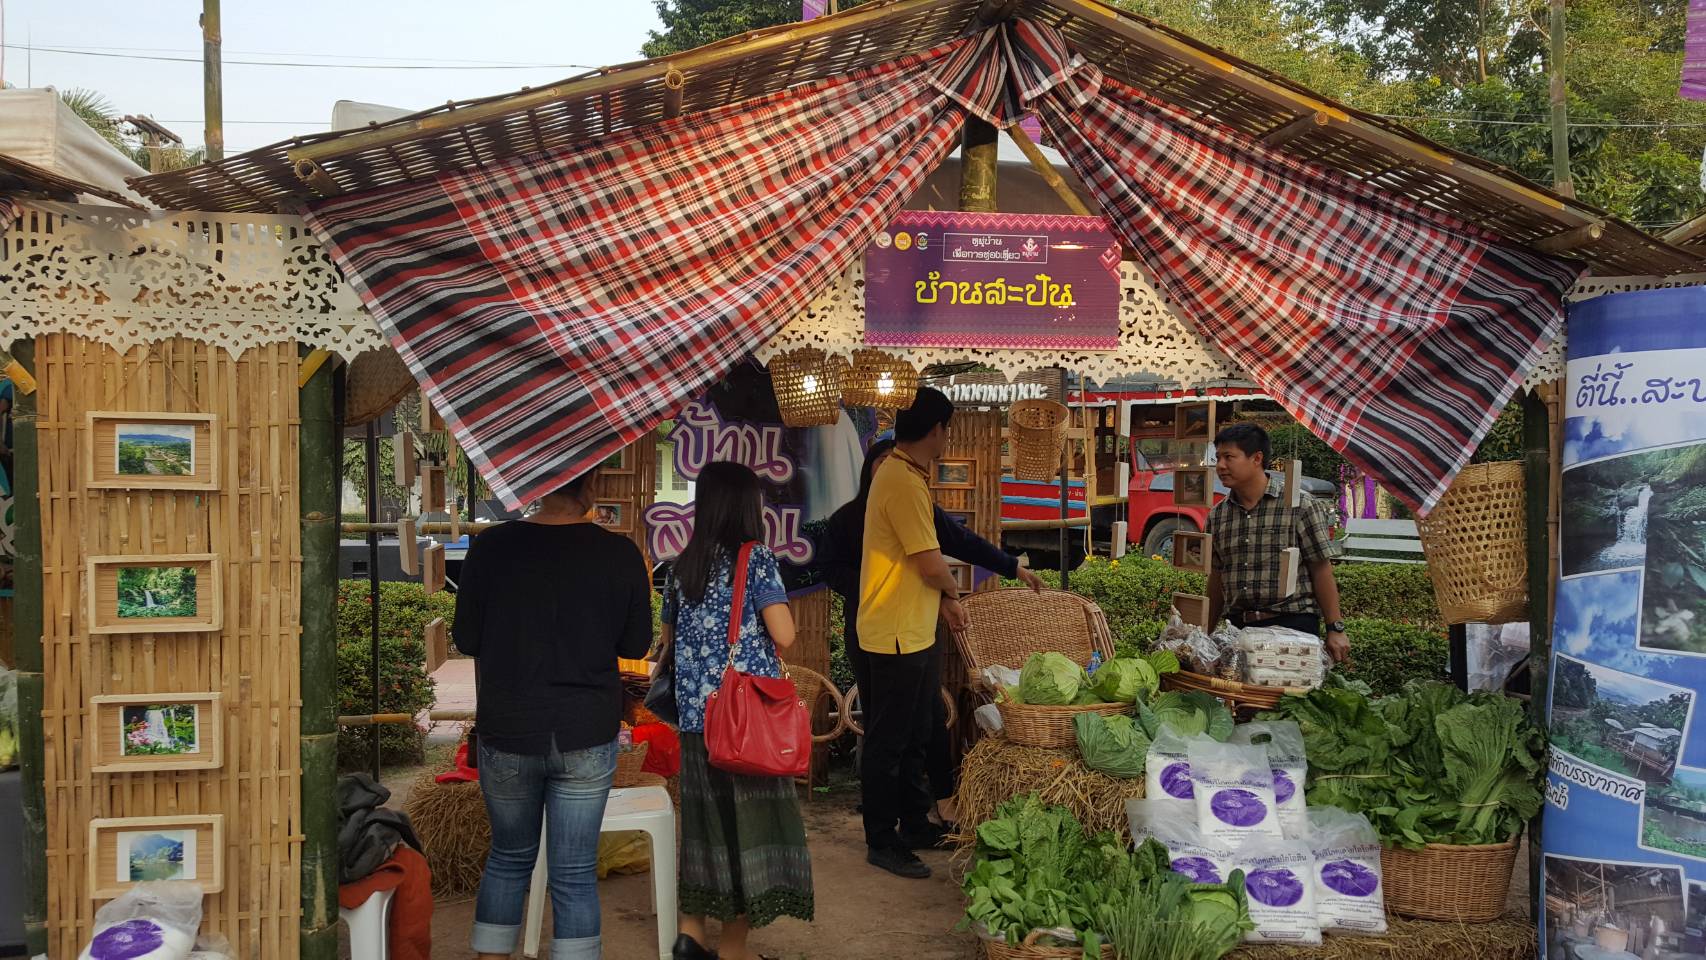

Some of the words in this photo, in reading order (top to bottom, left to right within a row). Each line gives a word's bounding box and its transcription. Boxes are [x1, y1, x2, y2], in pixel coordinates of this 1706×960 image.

[972, 235, 1003, 247] หมู่บ้าน
[952, 246, 1021, 261] เพื่อการท่องเที่ยว
[914, 271, 1073, 307] บ้านสะปัน
